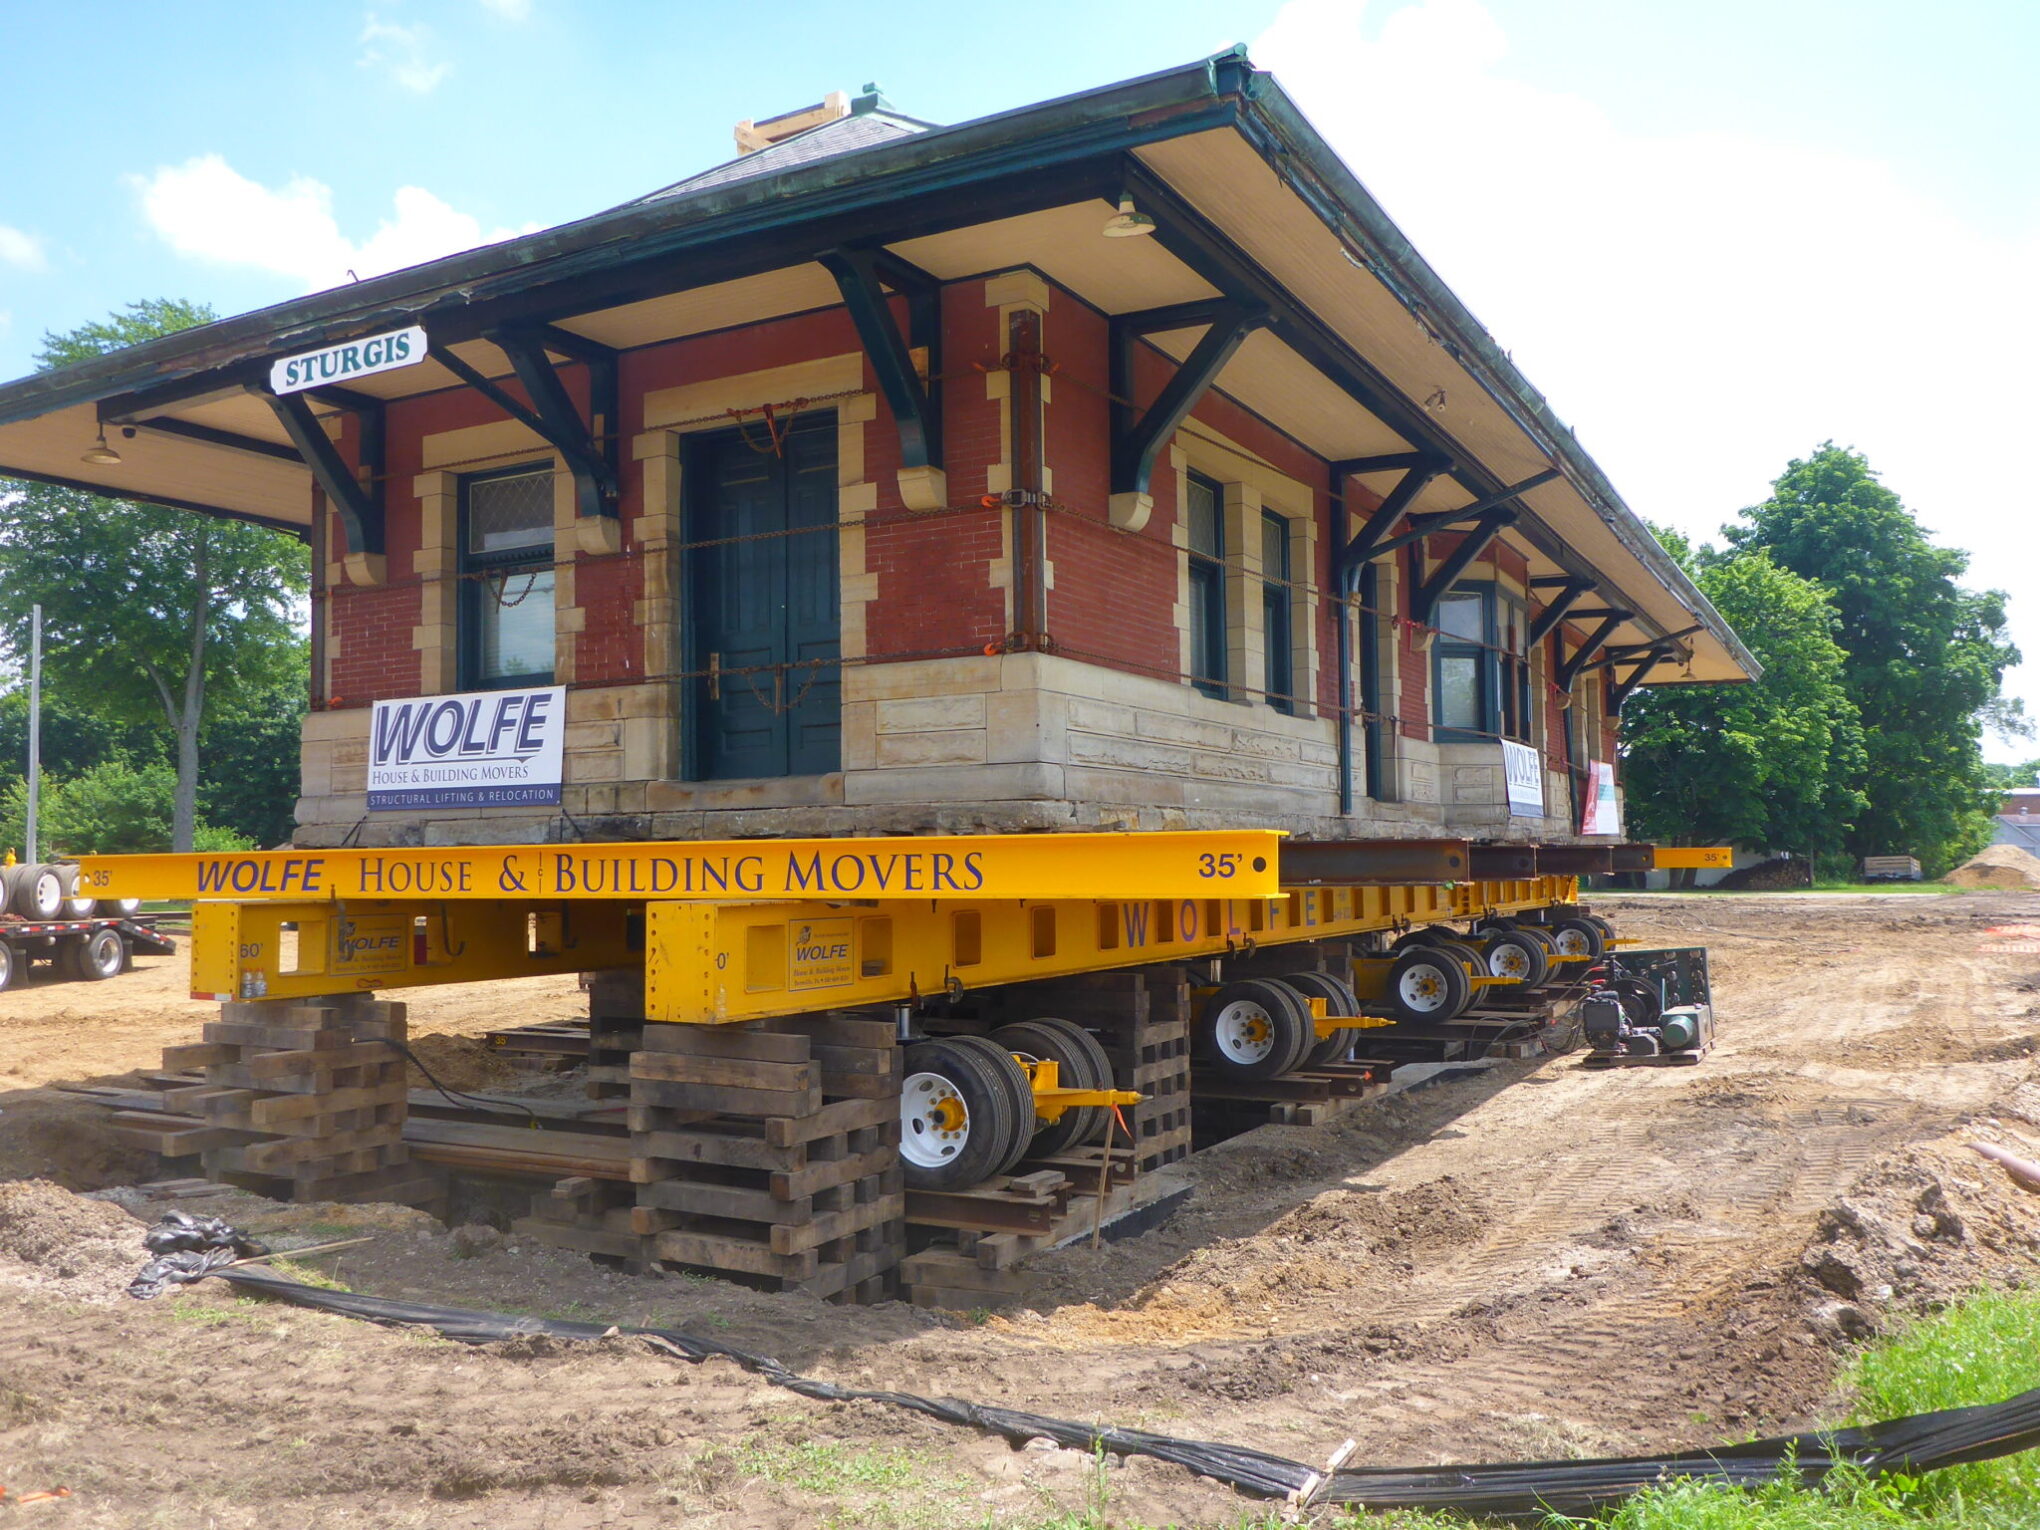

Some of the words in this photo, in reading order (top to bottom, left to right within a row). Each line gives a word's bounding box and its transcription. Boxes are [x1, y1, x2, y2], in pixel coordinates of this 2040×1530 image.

[286, 332, 410, 387] STURGIS
[373, 693, 553, 767] WOLFE
[411, 769, 420, 783] &
[1504, 743, 1540, 786] WOLFE
[370, 794, 432, 806] STRUCTURAL
[435, 791, 474, 804] LIFTING
[478, 792, 485, 801] &
[489, 789, 555, 801] RELOCATION
[197, 858, 325, 893] WOLFE
[498, 854, 530, 893] &
[1198, 853, 1243, 878] 35'
[796, 943, 849, 961] WOLFE
